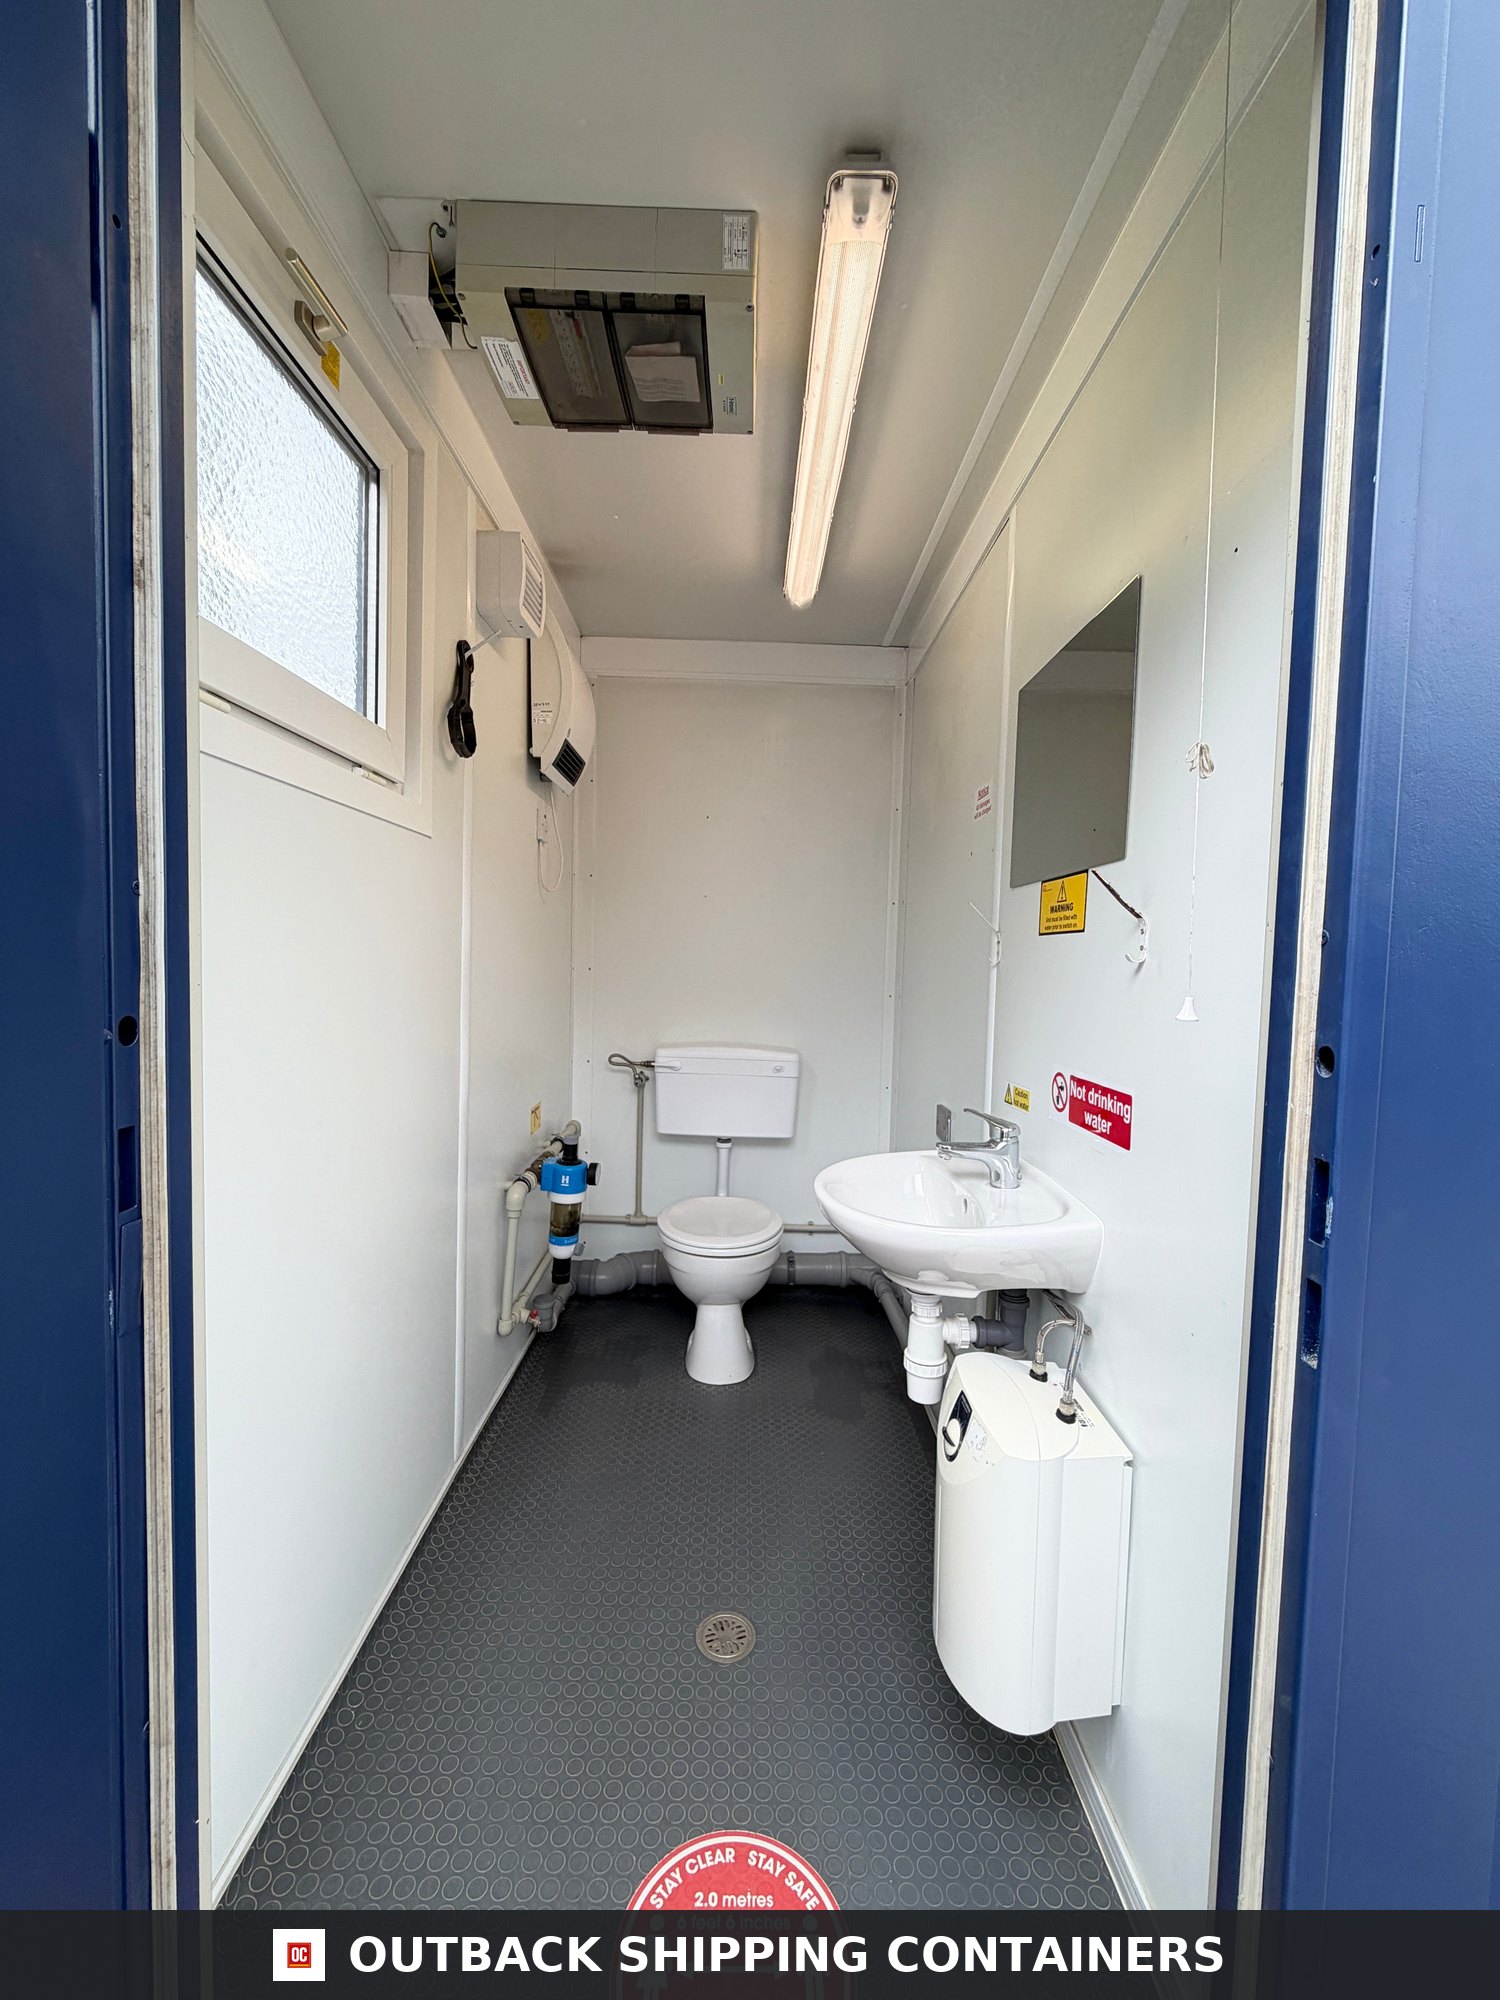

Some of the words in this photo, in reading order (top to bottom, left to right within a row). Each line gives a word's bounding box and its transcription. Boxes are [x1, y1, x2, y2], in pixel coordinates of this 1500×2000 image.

[1050, 902, 1073, 914] WARNING
[1014, 1087, 1028, 1100] Caution
[1070, 1080, 1086, 1102] Not
[1088, 1090, 1131, 1124] drinking
[1084, 1111, 1112, 1135] water
[650, 1870, 683, 1909] STAY
[685, 1847, 735, 1875] CLEAR
[748, 1850, 785, 1878] STAY
[784, 1871, 820, 1910] SAFE
[694, 1891, 718, 1908] 2.0
[722, 1891, 774, 1908] metres
[676, 1914, 687, 1931] 6
[691, 1913, 722, 1931] feet
[725, 1913, 736, 1931] 6
[740, 1913, 792, 1931] inches
